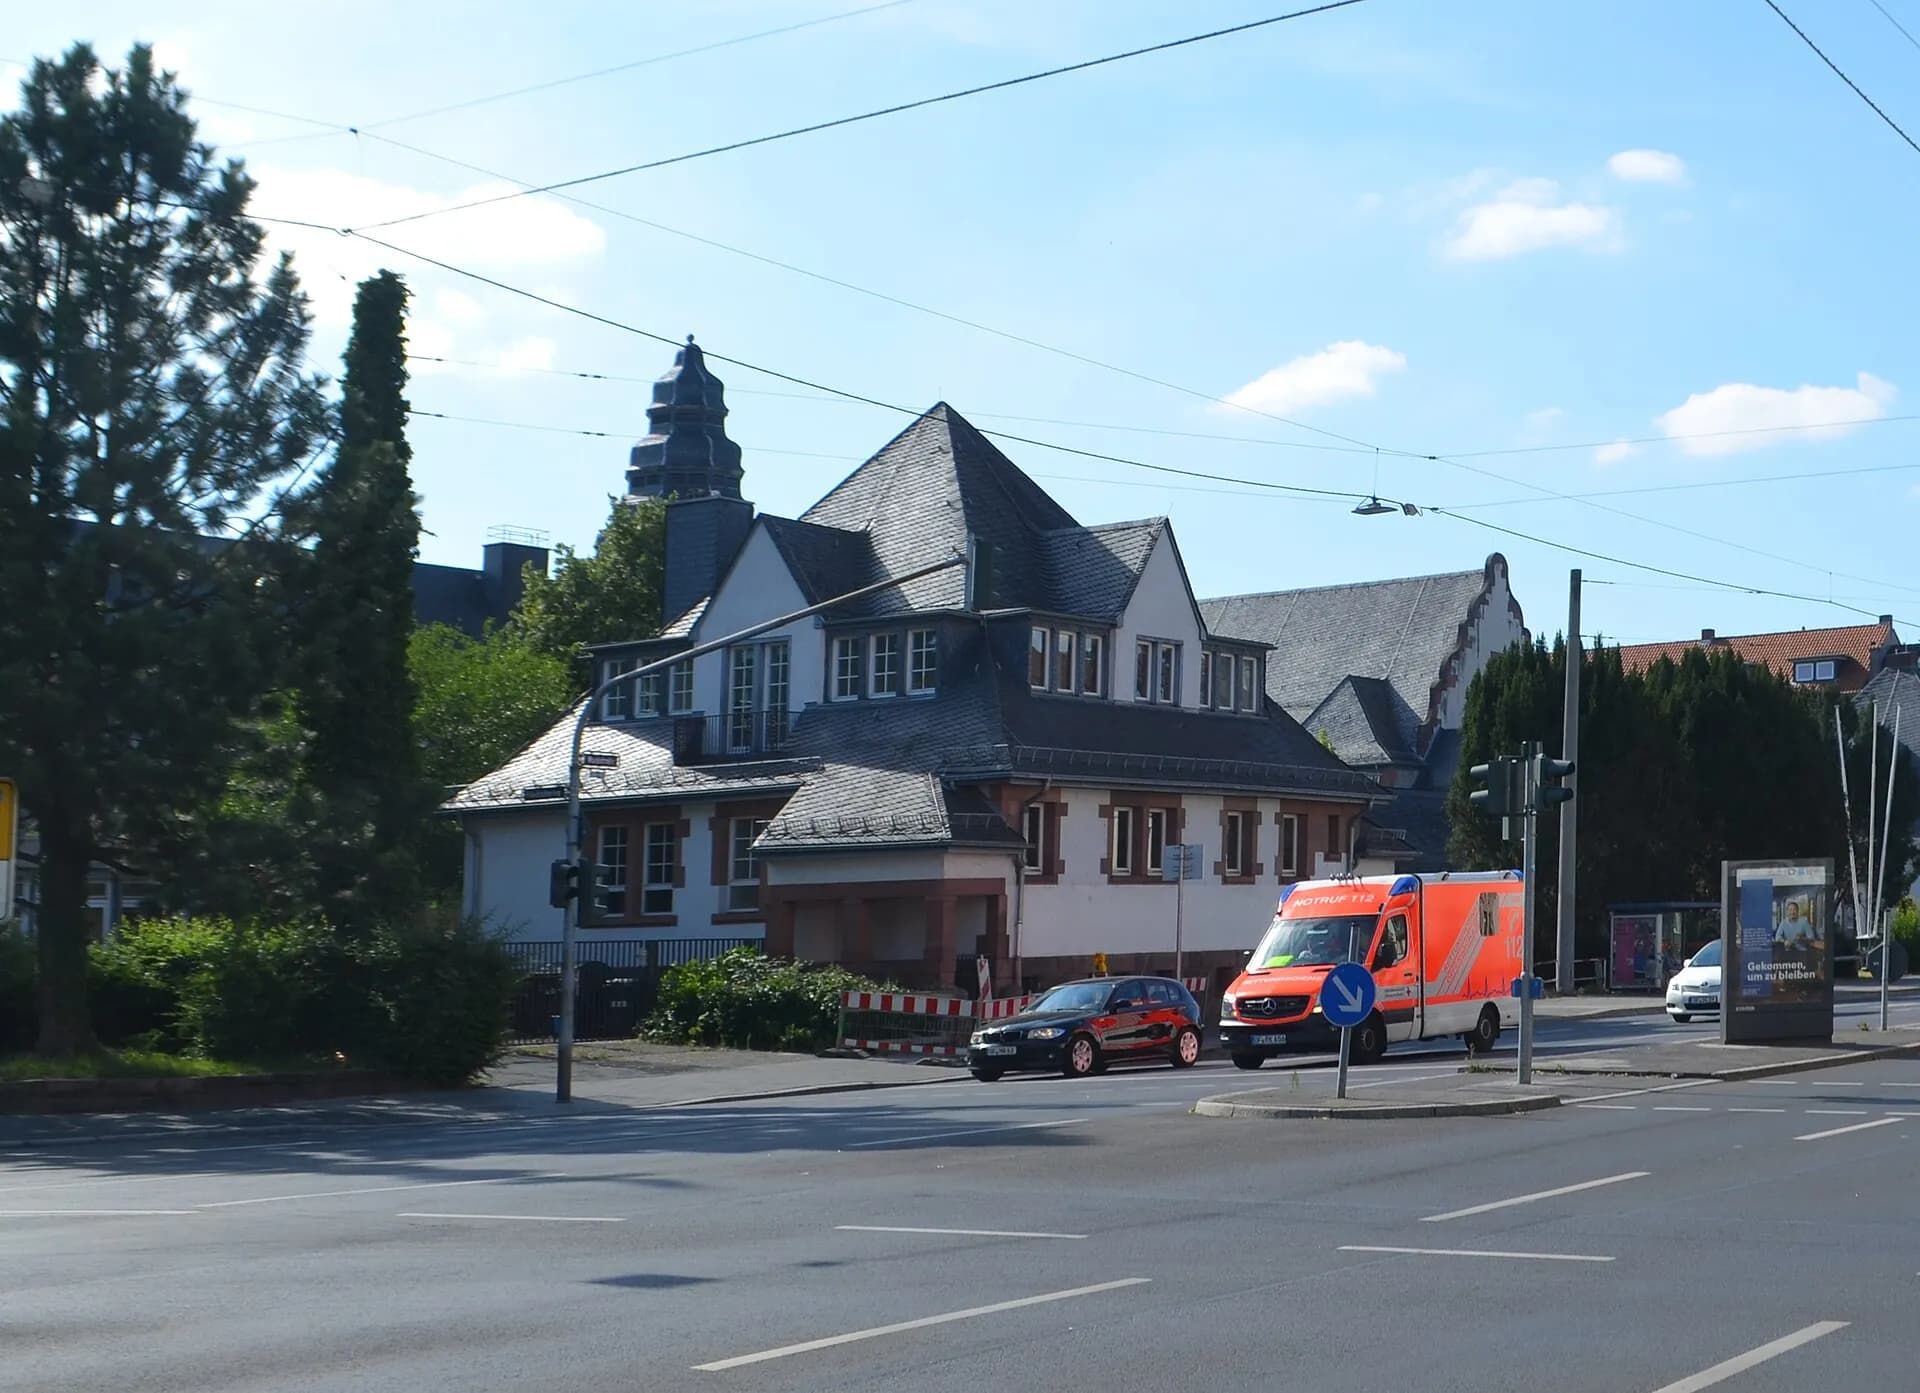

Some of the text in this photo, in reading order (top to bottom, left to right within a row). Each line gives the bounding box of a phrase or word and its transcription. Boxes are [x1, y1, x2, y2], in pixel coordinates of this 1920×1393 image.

[1292, 894, 1375, 907] NOTRUF 112
[1747, 961, 1806, 971] Gekommen,
[1747, 969, 1816, 981] um zu bleiben
